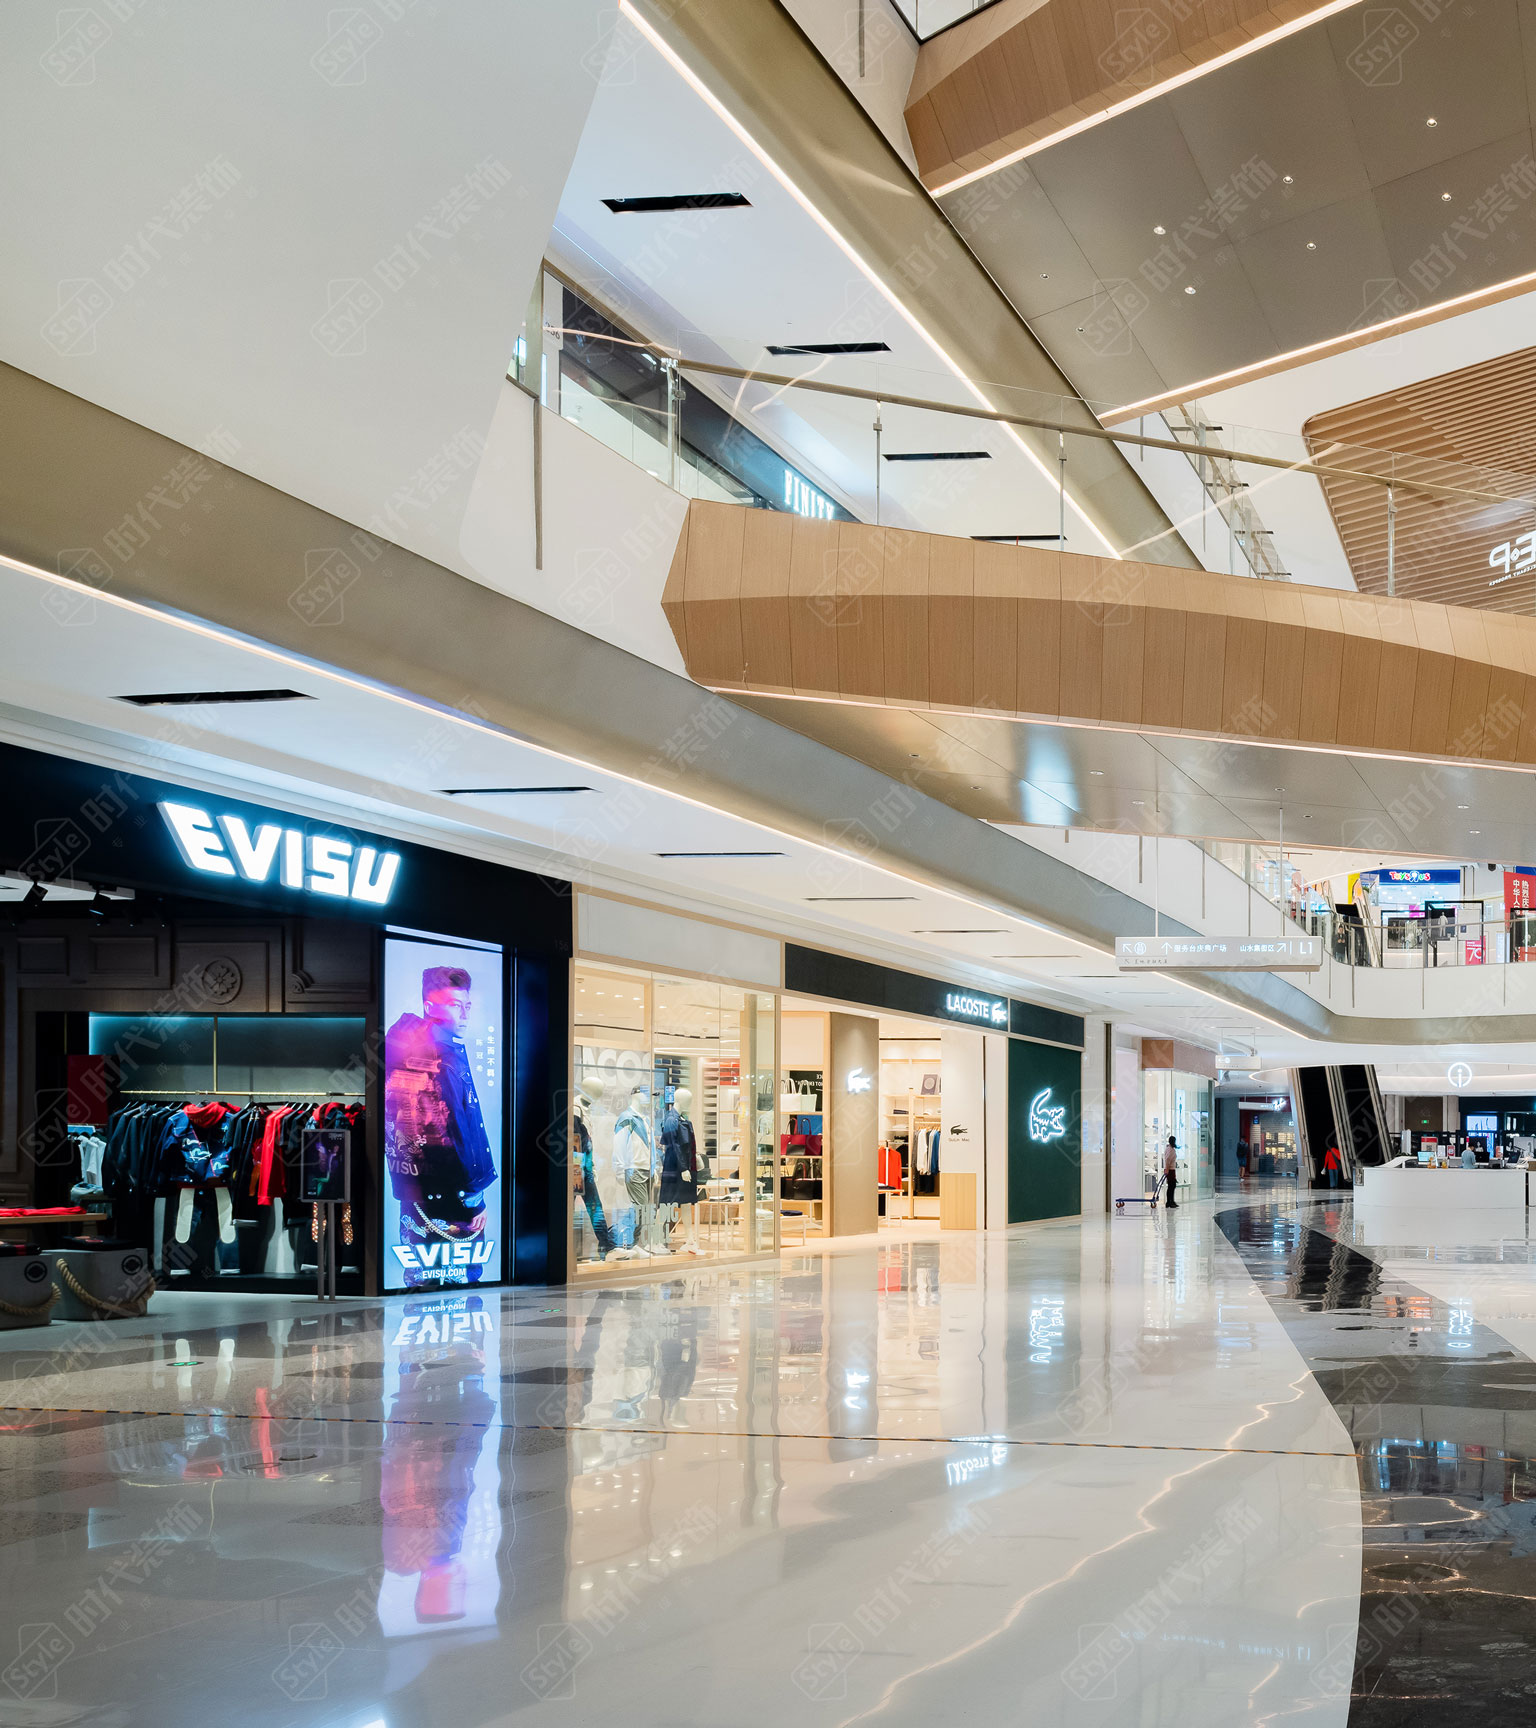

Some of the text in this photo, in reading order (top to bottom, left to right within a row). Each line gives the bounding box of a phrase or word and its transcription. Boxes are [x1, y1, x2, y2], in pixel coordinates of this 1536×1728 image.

[156, 801, 401, 904] EVISU
[1299, 941, 1313, 954] L1
[946, 993, 989, 1018] LACOSTE
[392, 1241, 495, 1268] EVISU
[422, 1268, 466, 1279] EVISU.COM
